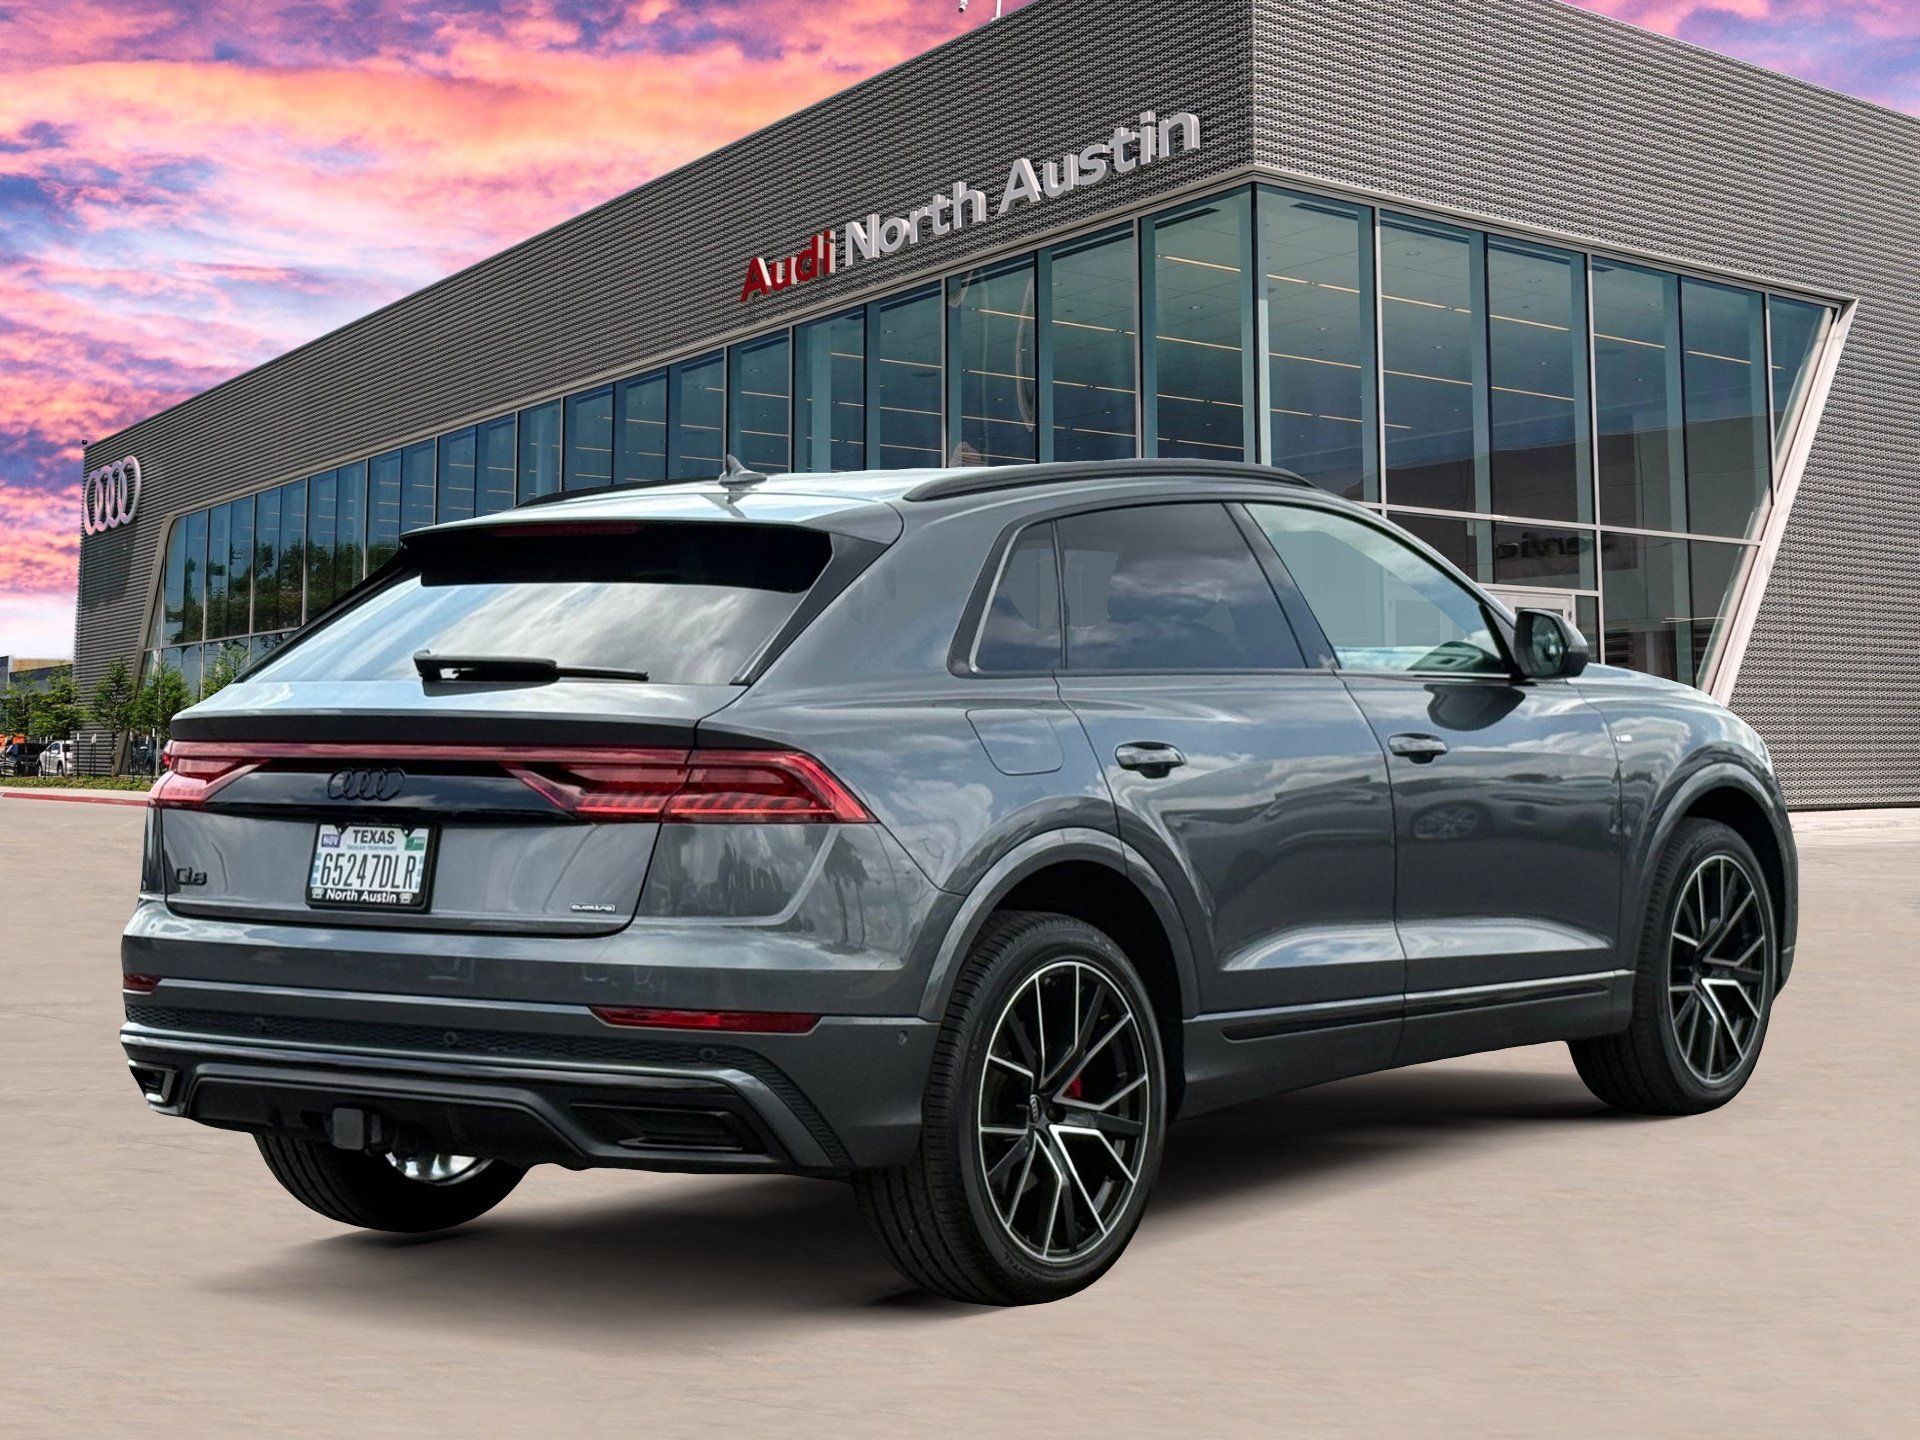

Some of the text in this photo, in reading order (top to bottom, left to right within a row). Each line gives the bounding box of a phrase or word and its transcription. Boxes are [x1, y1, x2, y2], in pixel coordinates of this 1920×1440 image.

[741, 110, 1201, 302] Audi North Austin
[353, 829, 395, 844] TEXAS
[175, 866, 207, 886] Q8
[320, 852, 417, 890] 65247DLR
[326, 888, 397, 904] North Austin
